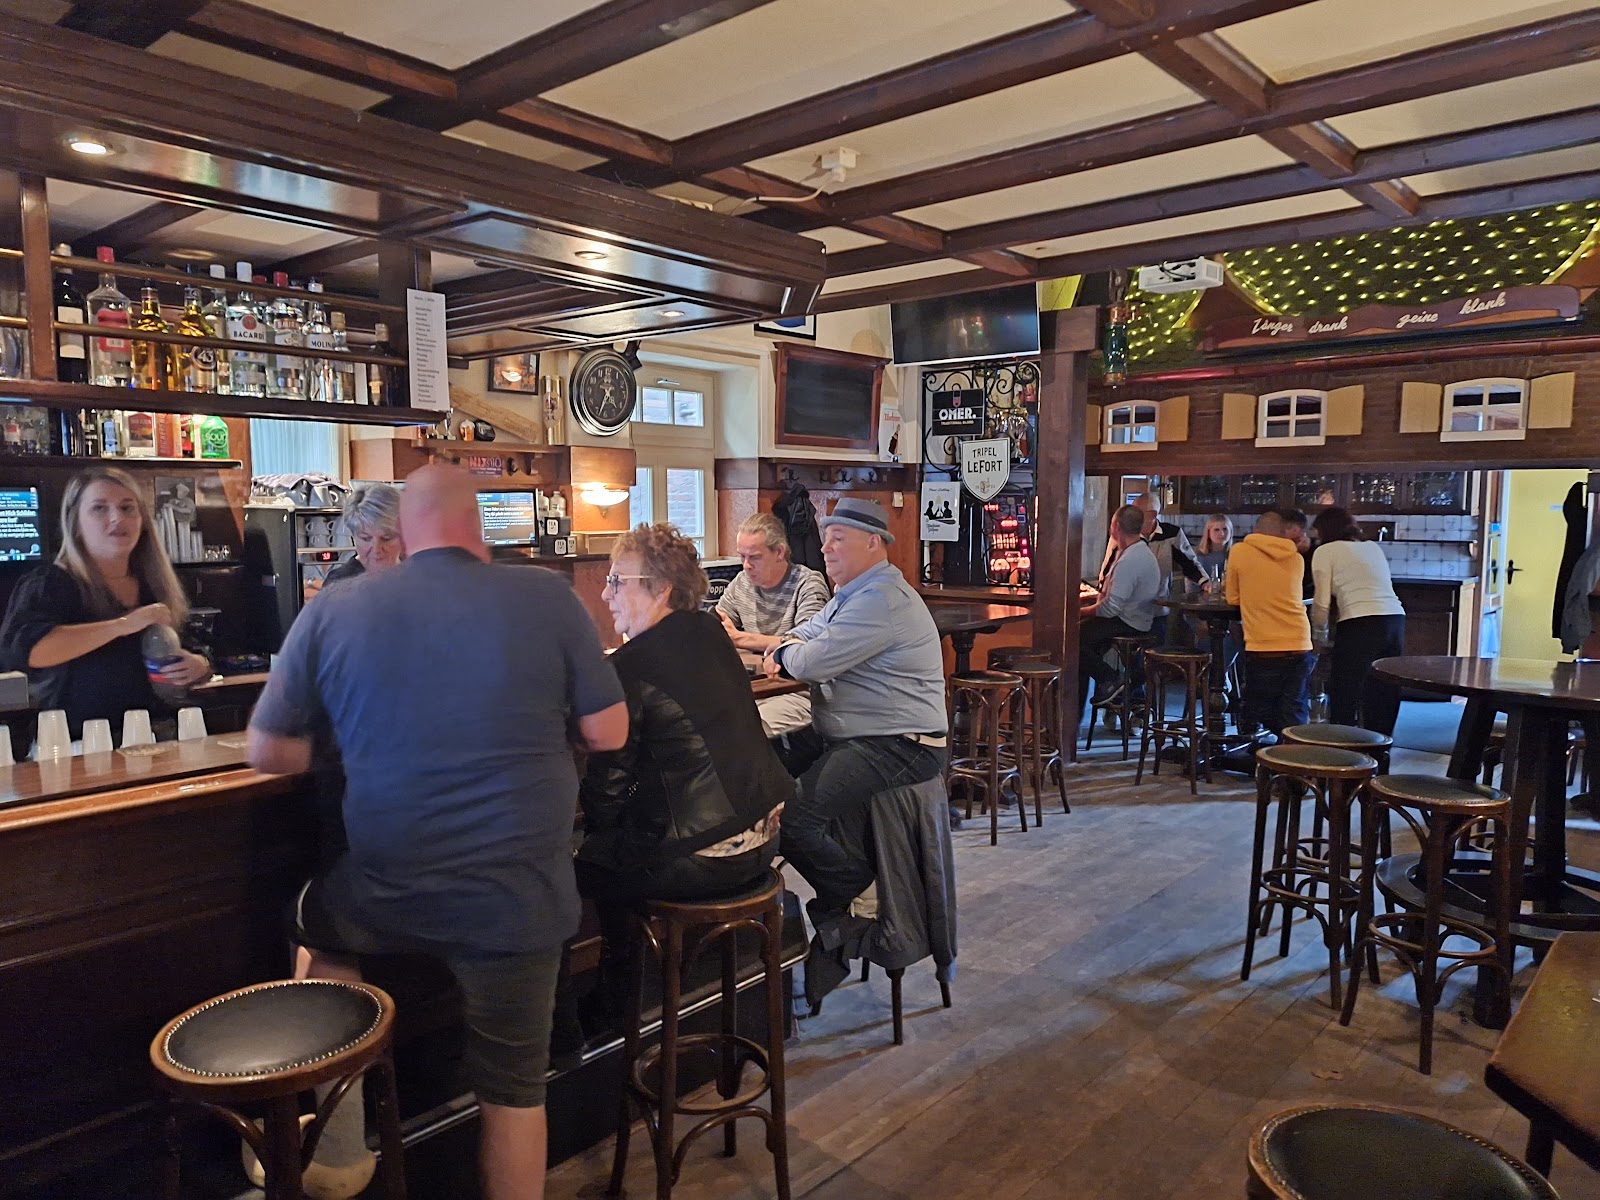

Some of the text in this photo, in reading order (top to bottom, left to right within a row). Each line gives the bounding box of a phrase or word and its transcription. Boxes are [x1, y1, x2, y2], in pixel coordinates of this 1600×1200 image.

[1308, 315, 1349, 334] drank
[1395, 310, 1439, 329] geine
[1459, 291, 1507, 315] klank
[197, 349, 214, 363] 43
[972, 446, 998, 459] TRIPEL
[709, 585, 726, 595] opp
